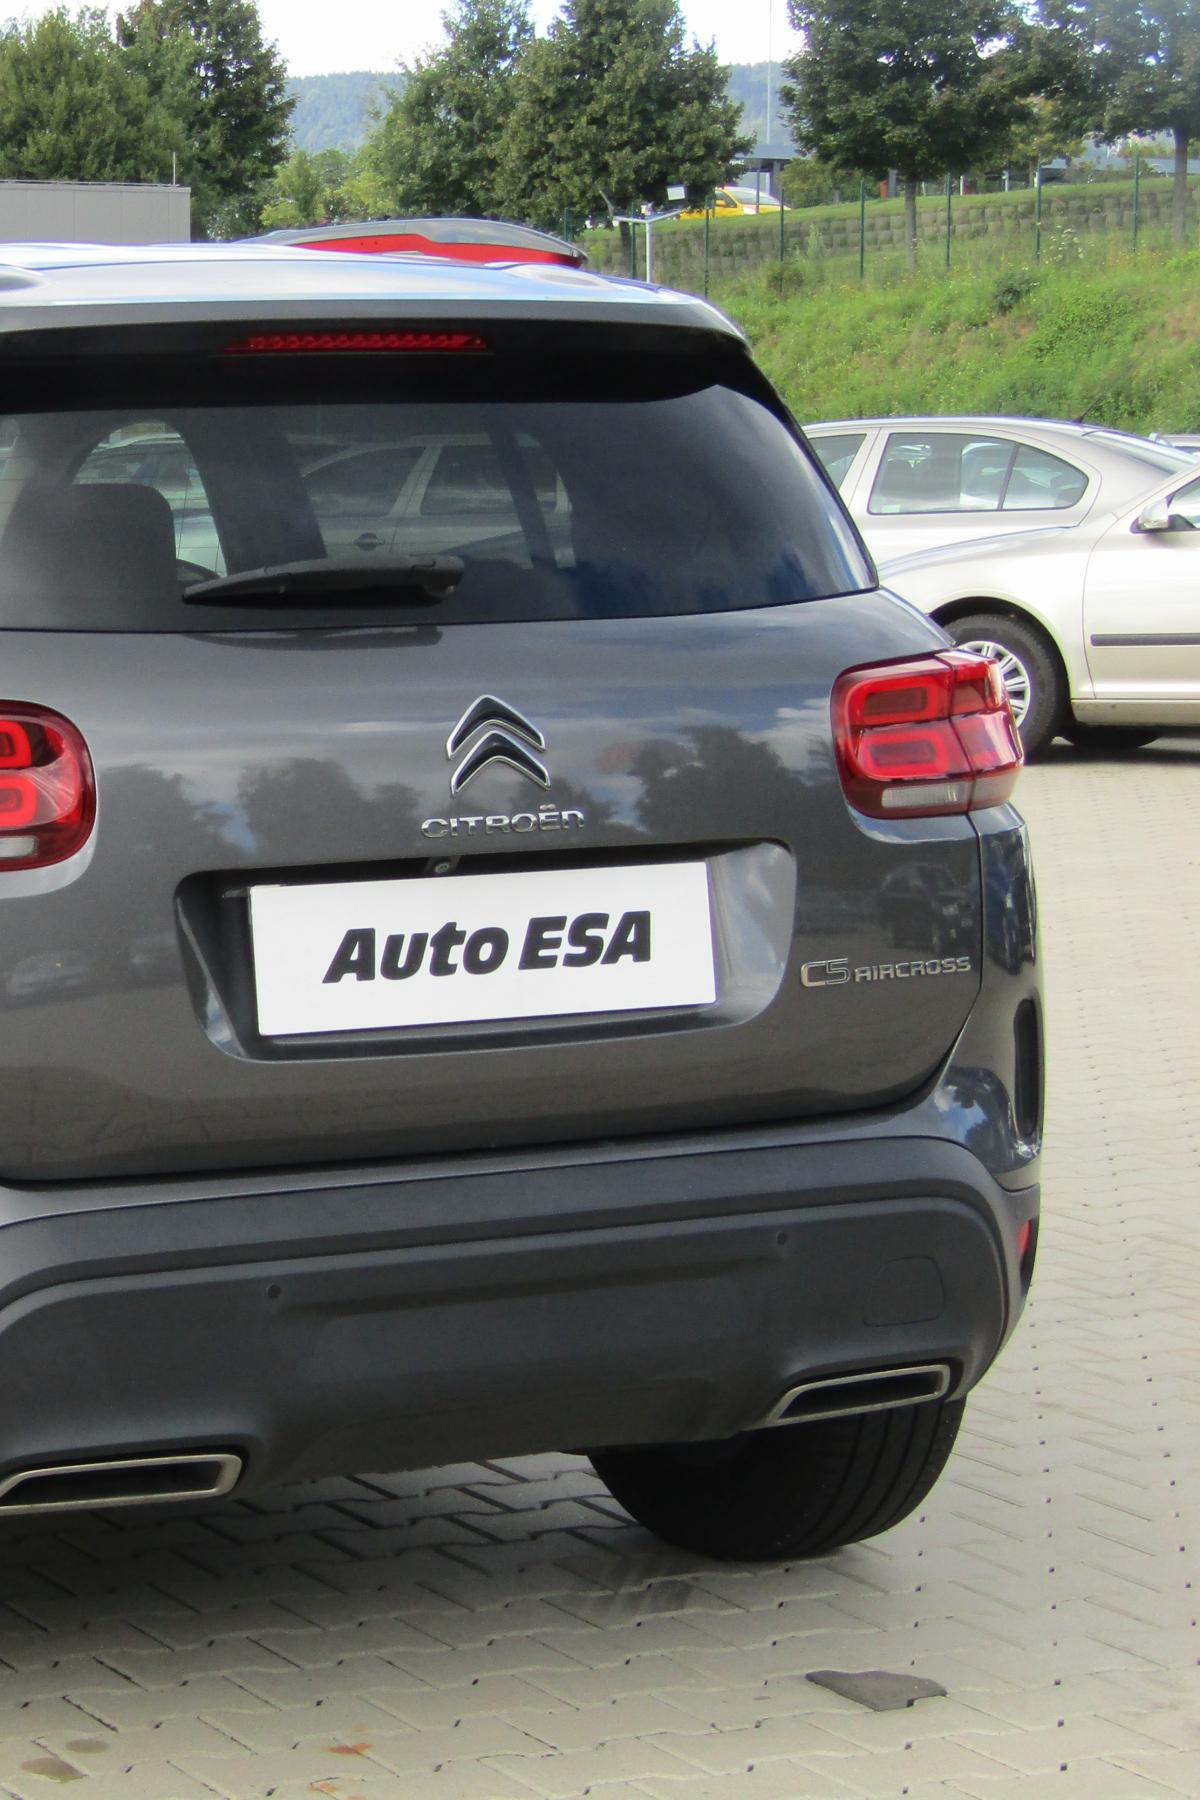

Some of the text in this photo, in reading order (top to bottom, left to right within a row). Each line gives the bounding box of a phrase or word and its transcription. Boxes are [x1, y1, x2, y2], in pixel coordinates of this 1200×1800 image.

[421, 803, 586, 838] CITROËN
[322, 910, 651, 984] Auto ESA
[800, 956, 972, 988] C5 AIRCROSS
